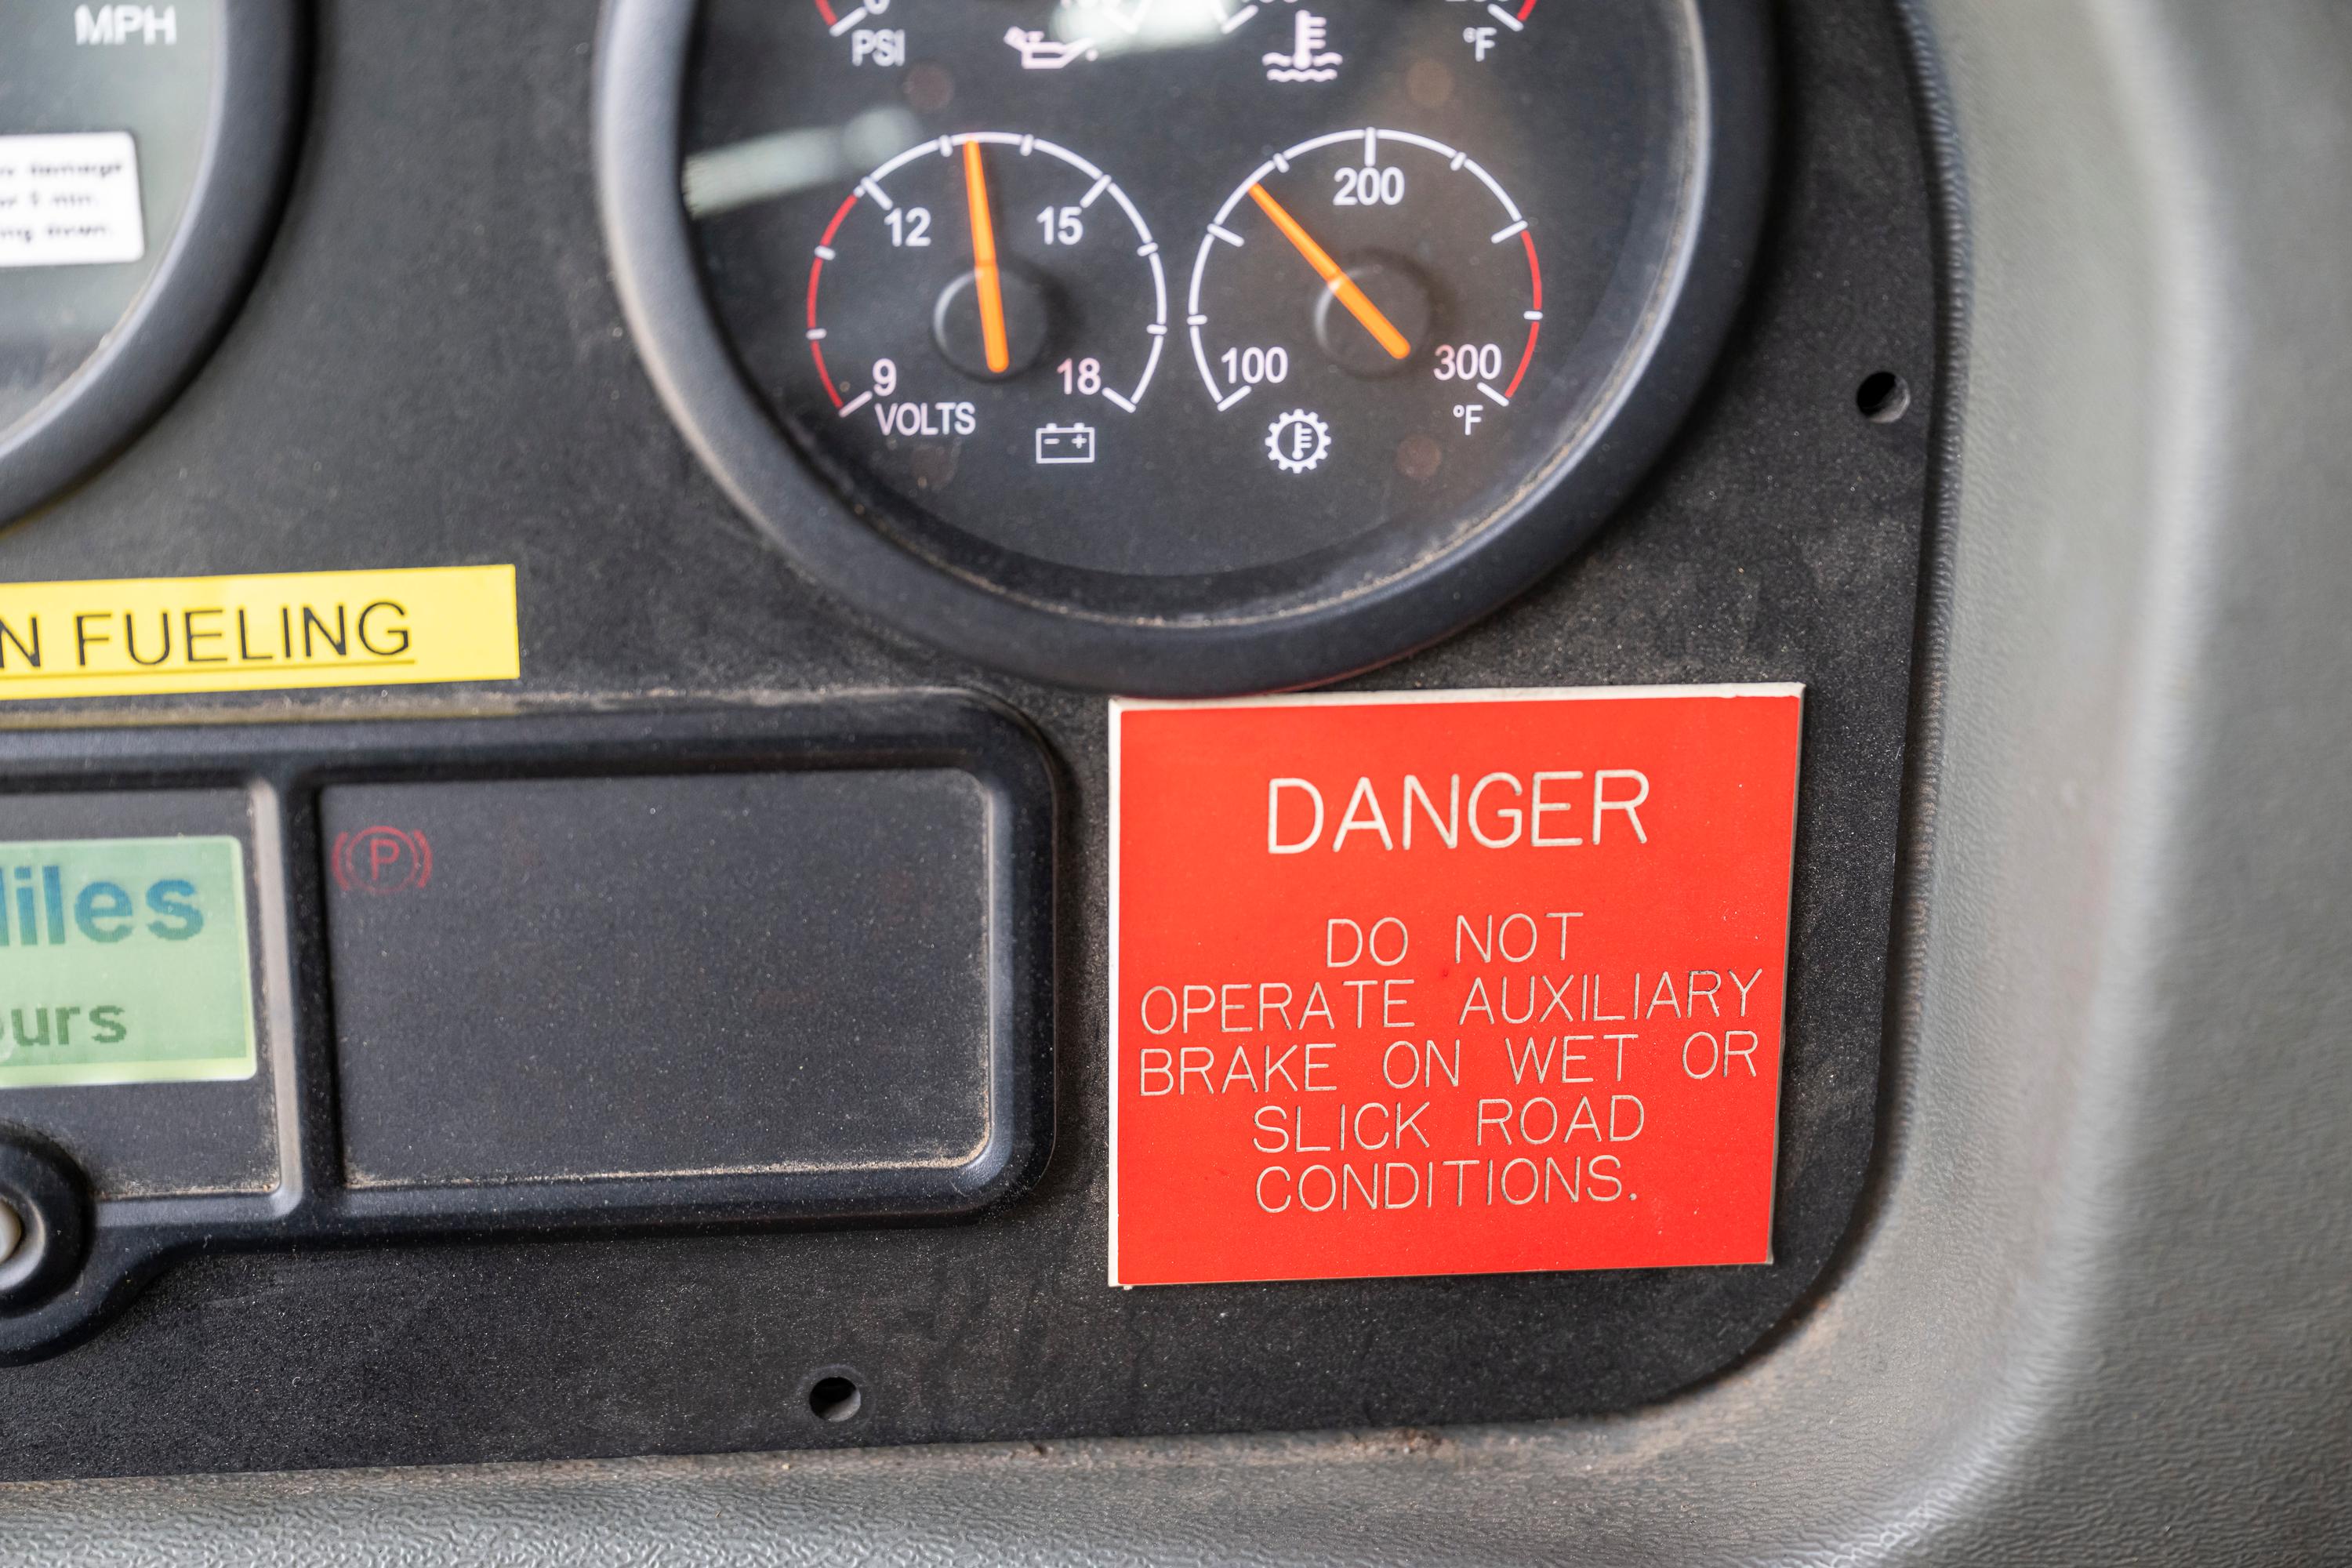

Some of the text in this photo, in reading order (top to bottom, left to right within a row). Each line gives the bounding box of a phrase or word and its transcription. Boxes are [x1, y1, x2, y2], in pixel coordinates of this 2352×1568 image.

[74, 5, 177, 45] MPH
[851, 28, 906, 67] PSI
[1332, 168, 1406, 206] 200
[884, 207, 931, 247] 12
[1036, 206, 1083, 245] 15
[872, 358, 897, 397] 9
[1056, 357, 1102, 396] 18
[1220, 346, 1289, 384] 100
[1433, 343, 1502, 381] 300
[874, 401, 976, 437] VOLTS
[75, 601, 410, 666] FUELING
[1267, 768, 1650, 855] DANGER
[0, 864, 204, 946] iles
[1327, 912, 1584, 968] DO NOT
[1141, 968, 1762, 1035] OPERATE AUXILIARY
[0, 1005, 127, 1047] urs
[1140, 1030, 1759, 1097] BRAKE ON WET OR
[1253, 1094, 1645, 1153] SLICK ROAD
[1256, 1154, 1639, 1214] CONDITIONS.
